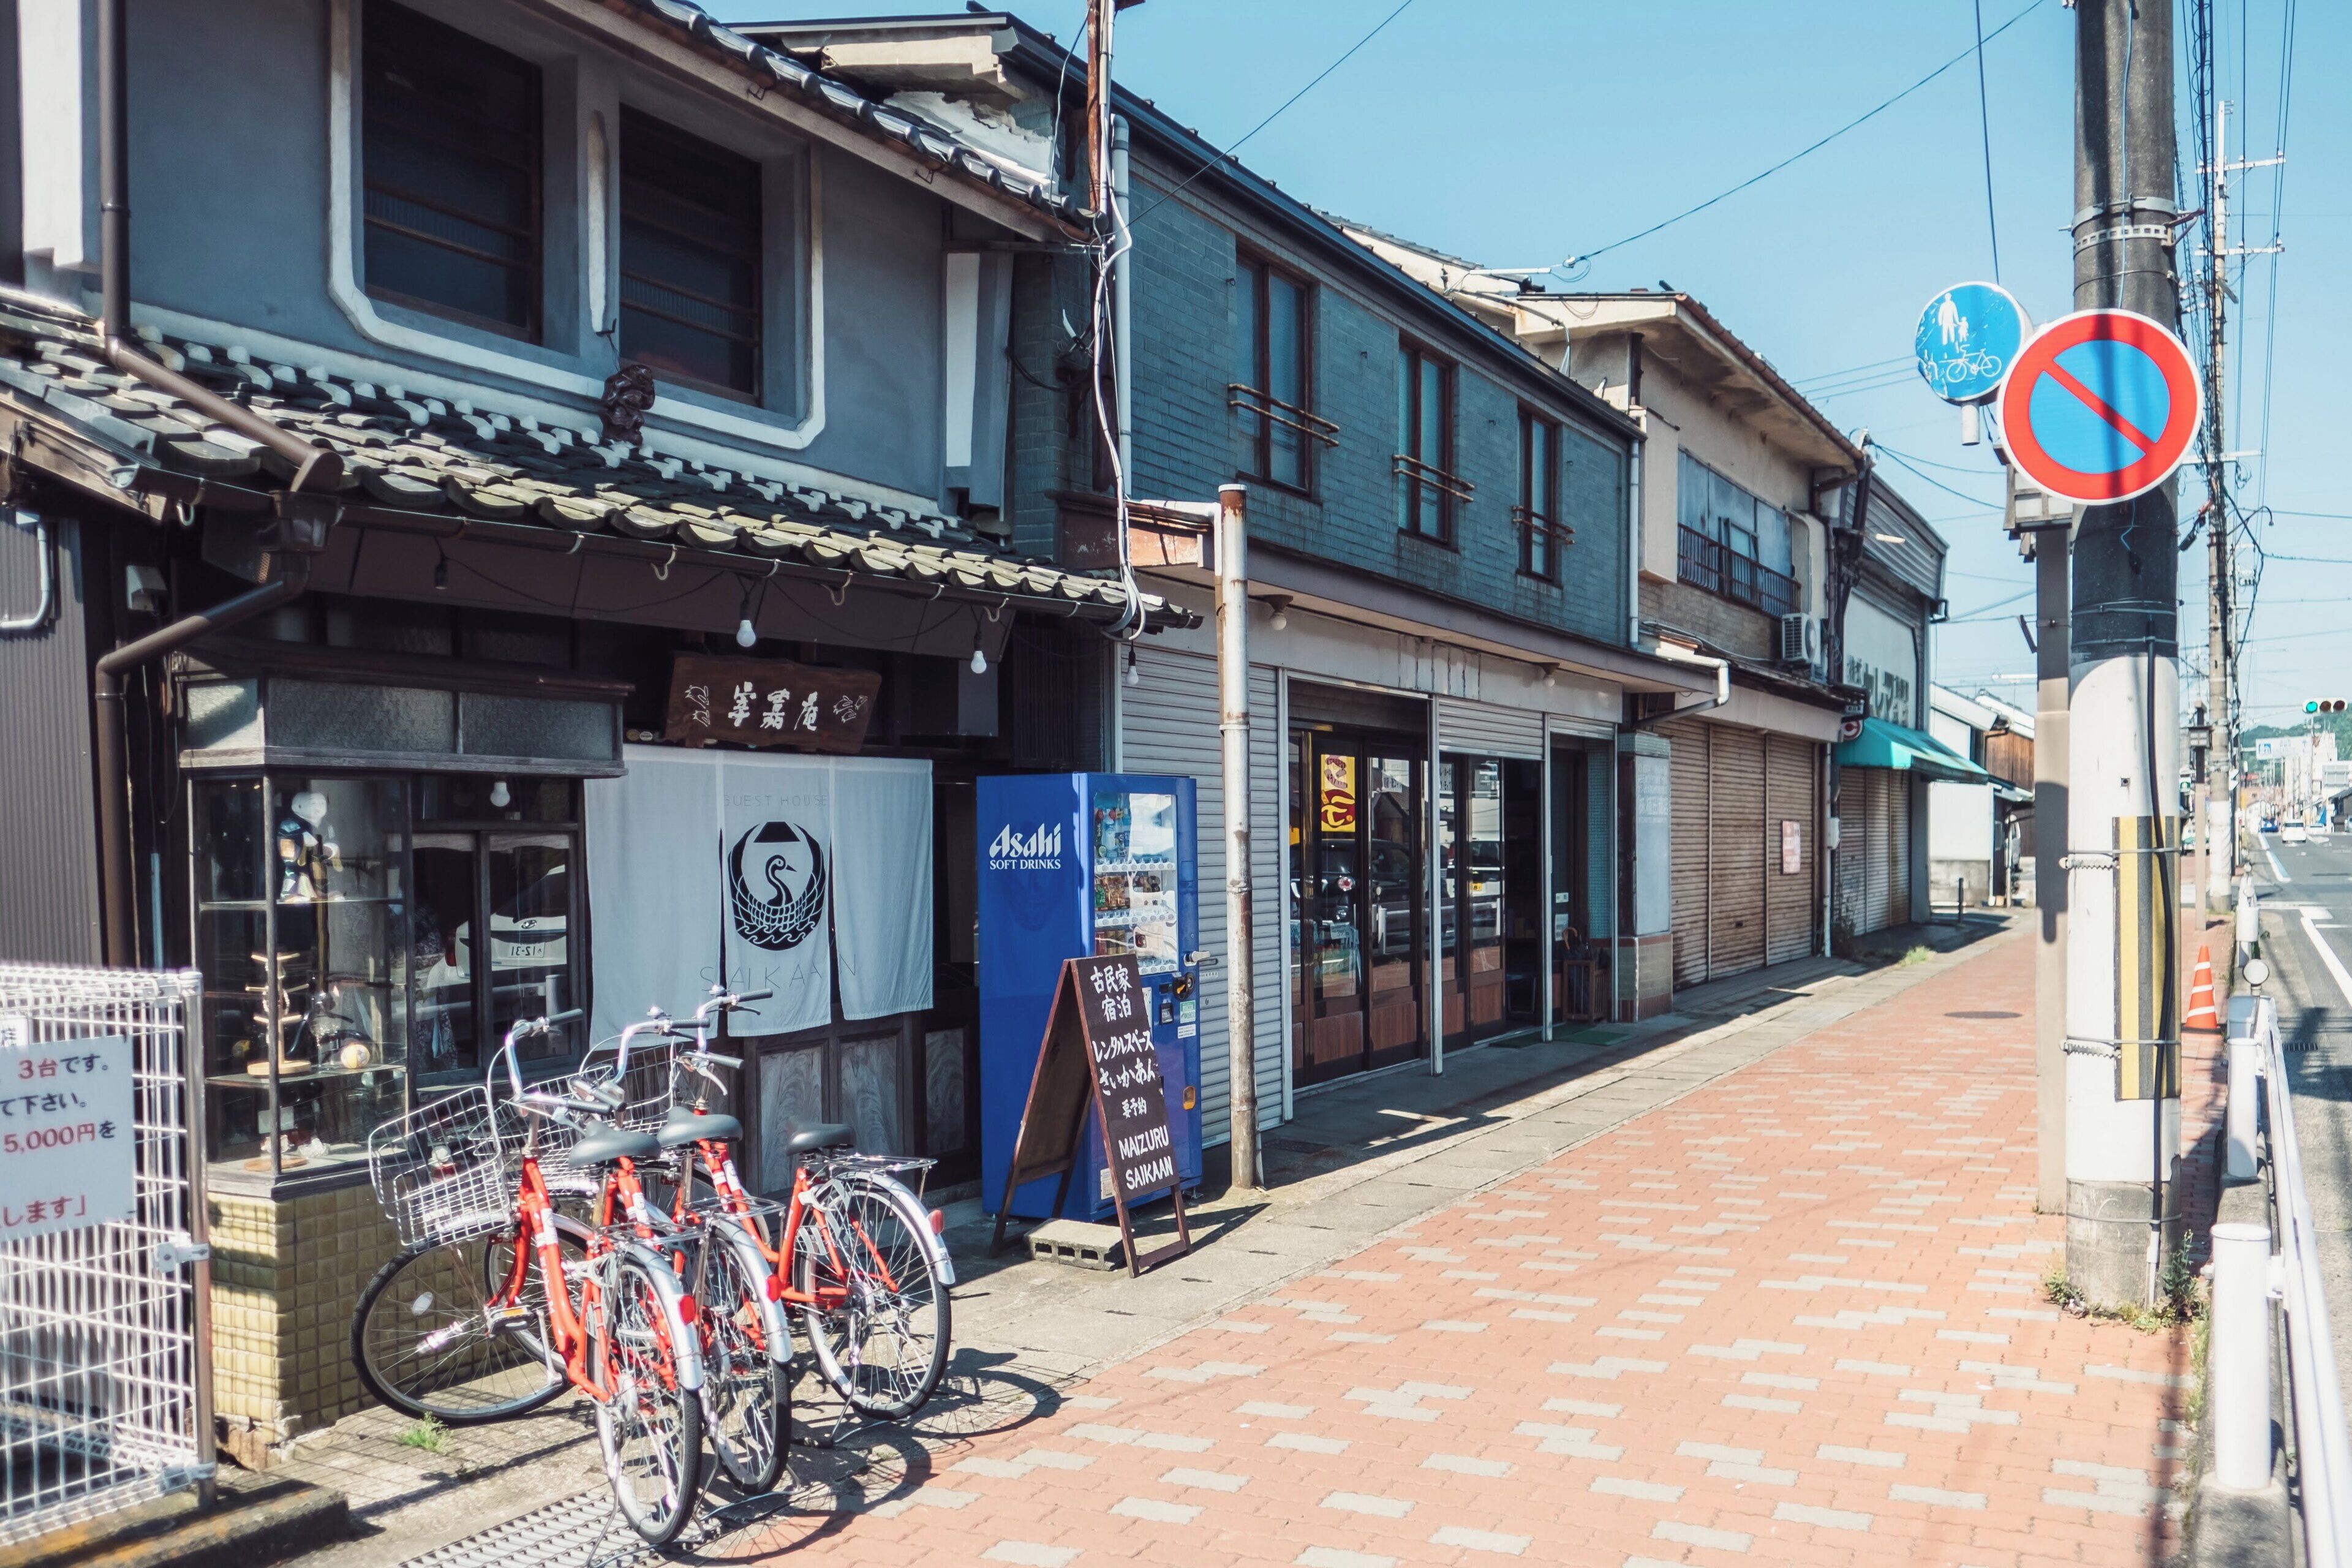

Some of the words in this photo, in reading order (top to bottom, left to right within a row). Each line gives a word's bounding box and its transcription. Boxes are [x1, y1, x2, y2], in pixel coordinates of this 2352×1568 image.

[724, 795, 772, 807] GUEST
[780, 795, 829, 807] HOUSE
[989, 823, 1061, 858] Asahi
[990, 859, 1017, 870] SOFT
[1020, 859, 1061, 869] DRINKS
[1090, 963, 1133, 993] 古民家
[1102, 993, 1132, 1022] 宿泊
[1092, 1029, 1155, 1063] レンタルスペース
[19, 1054, 109, 1080] 3台です。
[1099, 1057, 1158, 1096] さいかあん
[0, 1092, 86, 1116] て下さい。
[1121, 1096, 1147, 1119] 要予約
[4, 1120, 116, 1154] 5,000円を
[1118, 1125, 1169, 1160] MAIZURU
[1125, 1155, 1174, 1189] SAIKAAN
